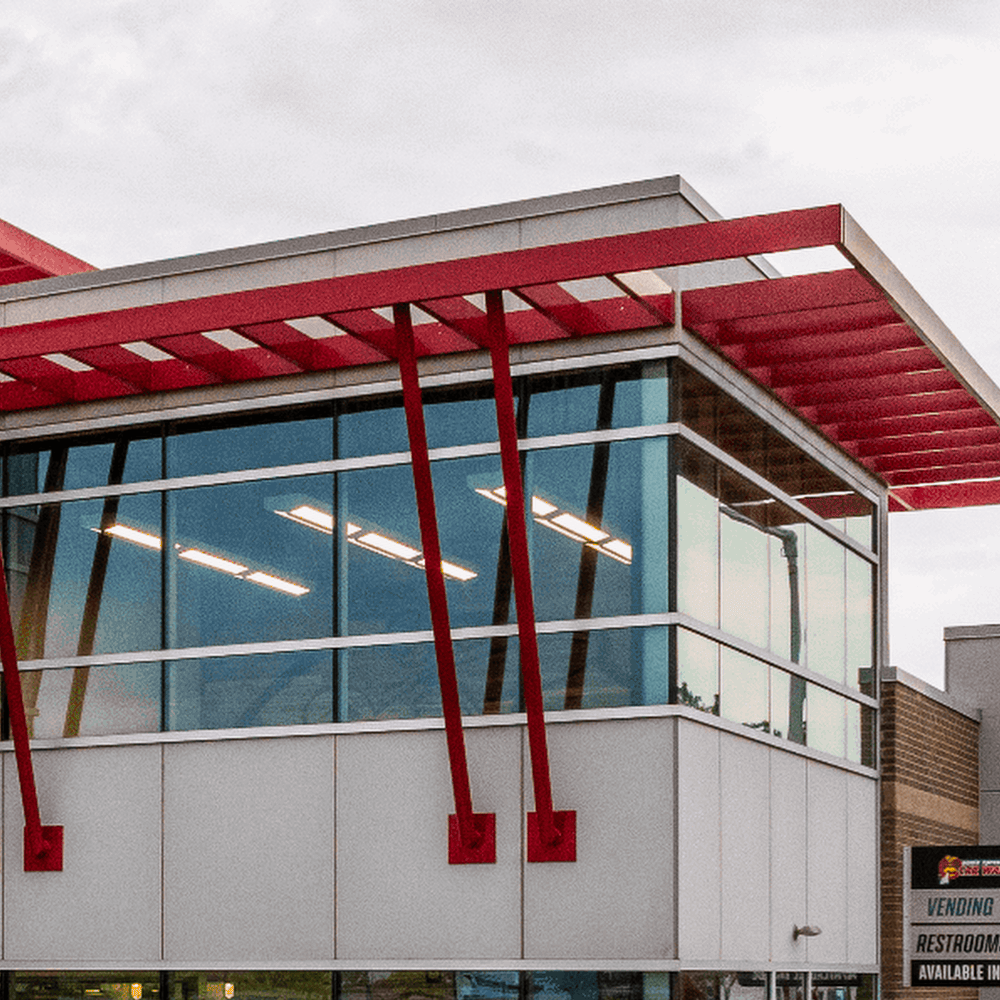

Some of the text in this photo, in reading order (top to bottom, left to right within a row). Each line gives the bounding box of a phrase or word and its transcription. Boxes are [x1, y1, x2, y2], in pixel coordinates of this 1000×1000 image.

[927, 897, 994, 917] VENDING
[916, 934, 1000, 953] RESTROOM
[918, 964, 984, 981] AVAILABLE
